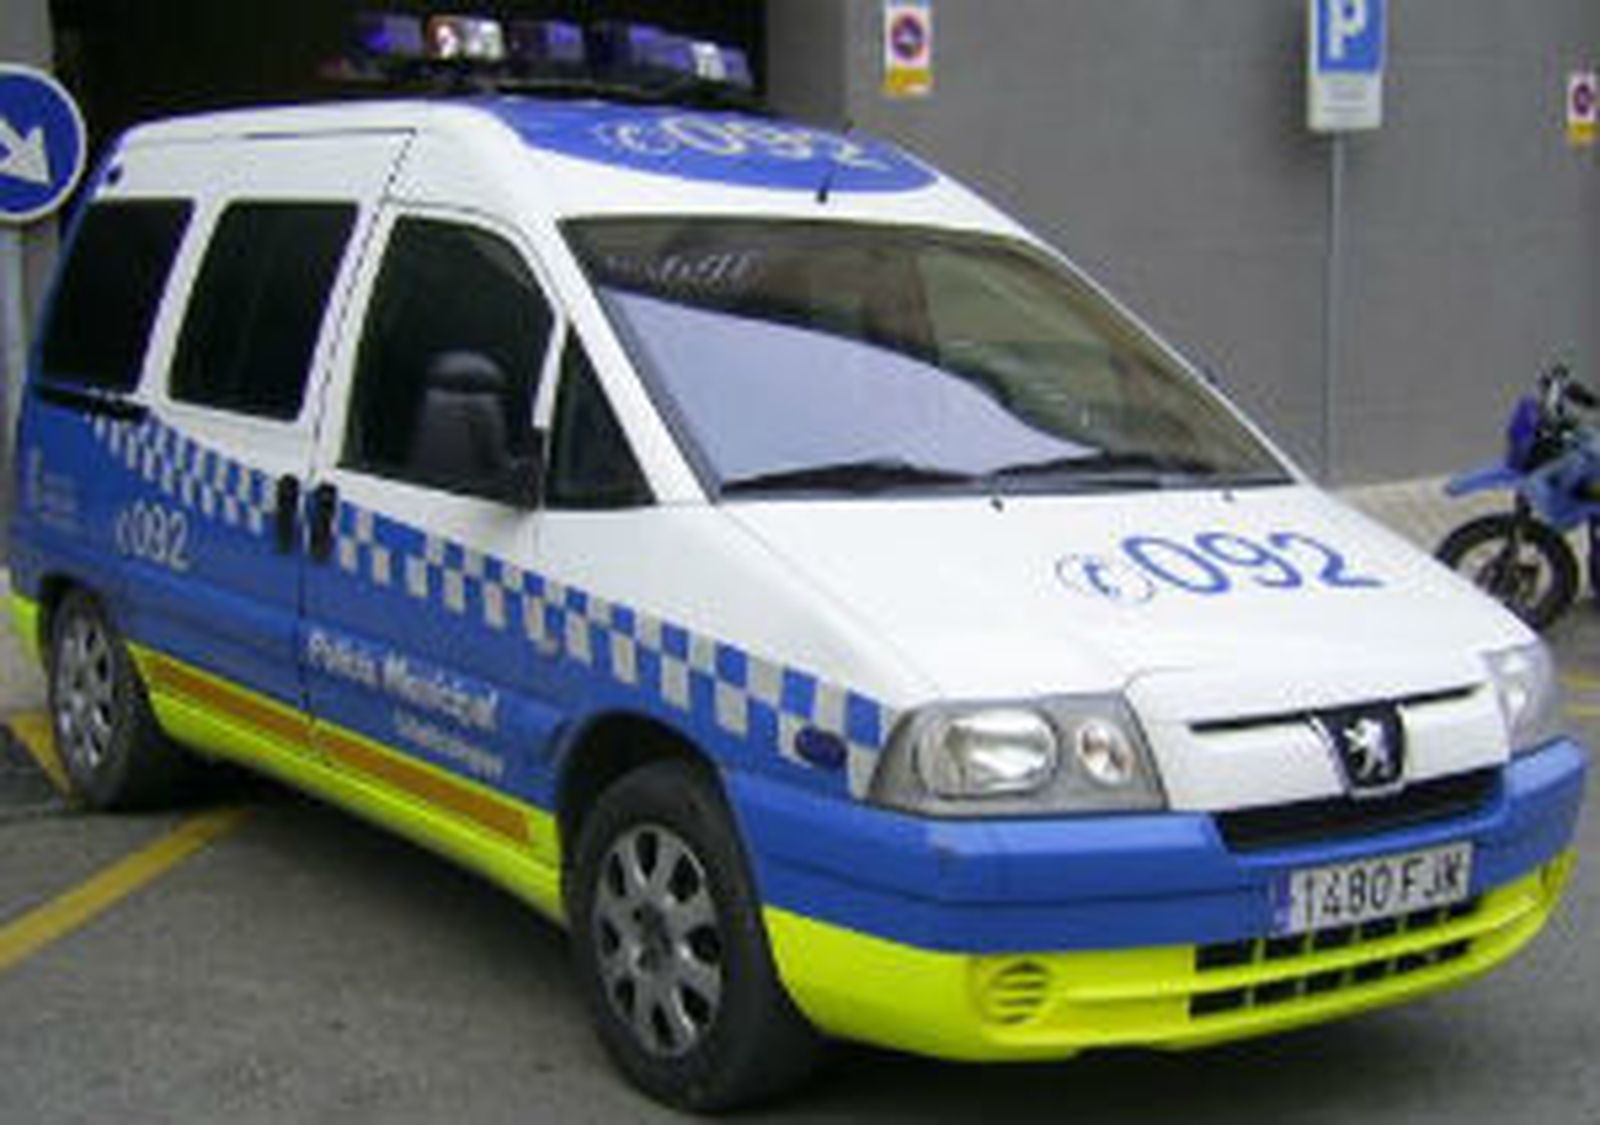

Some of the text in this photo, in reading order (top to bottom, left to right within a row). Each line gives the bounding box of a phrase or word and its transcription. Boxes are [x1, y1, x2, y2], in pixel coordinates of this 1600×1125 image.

[1329, 0, 1367, 59] P
[662, 115, 891, 172] 092
[131, 500, 190, 573] 092
[1122, 532, 1385, 593] 092
